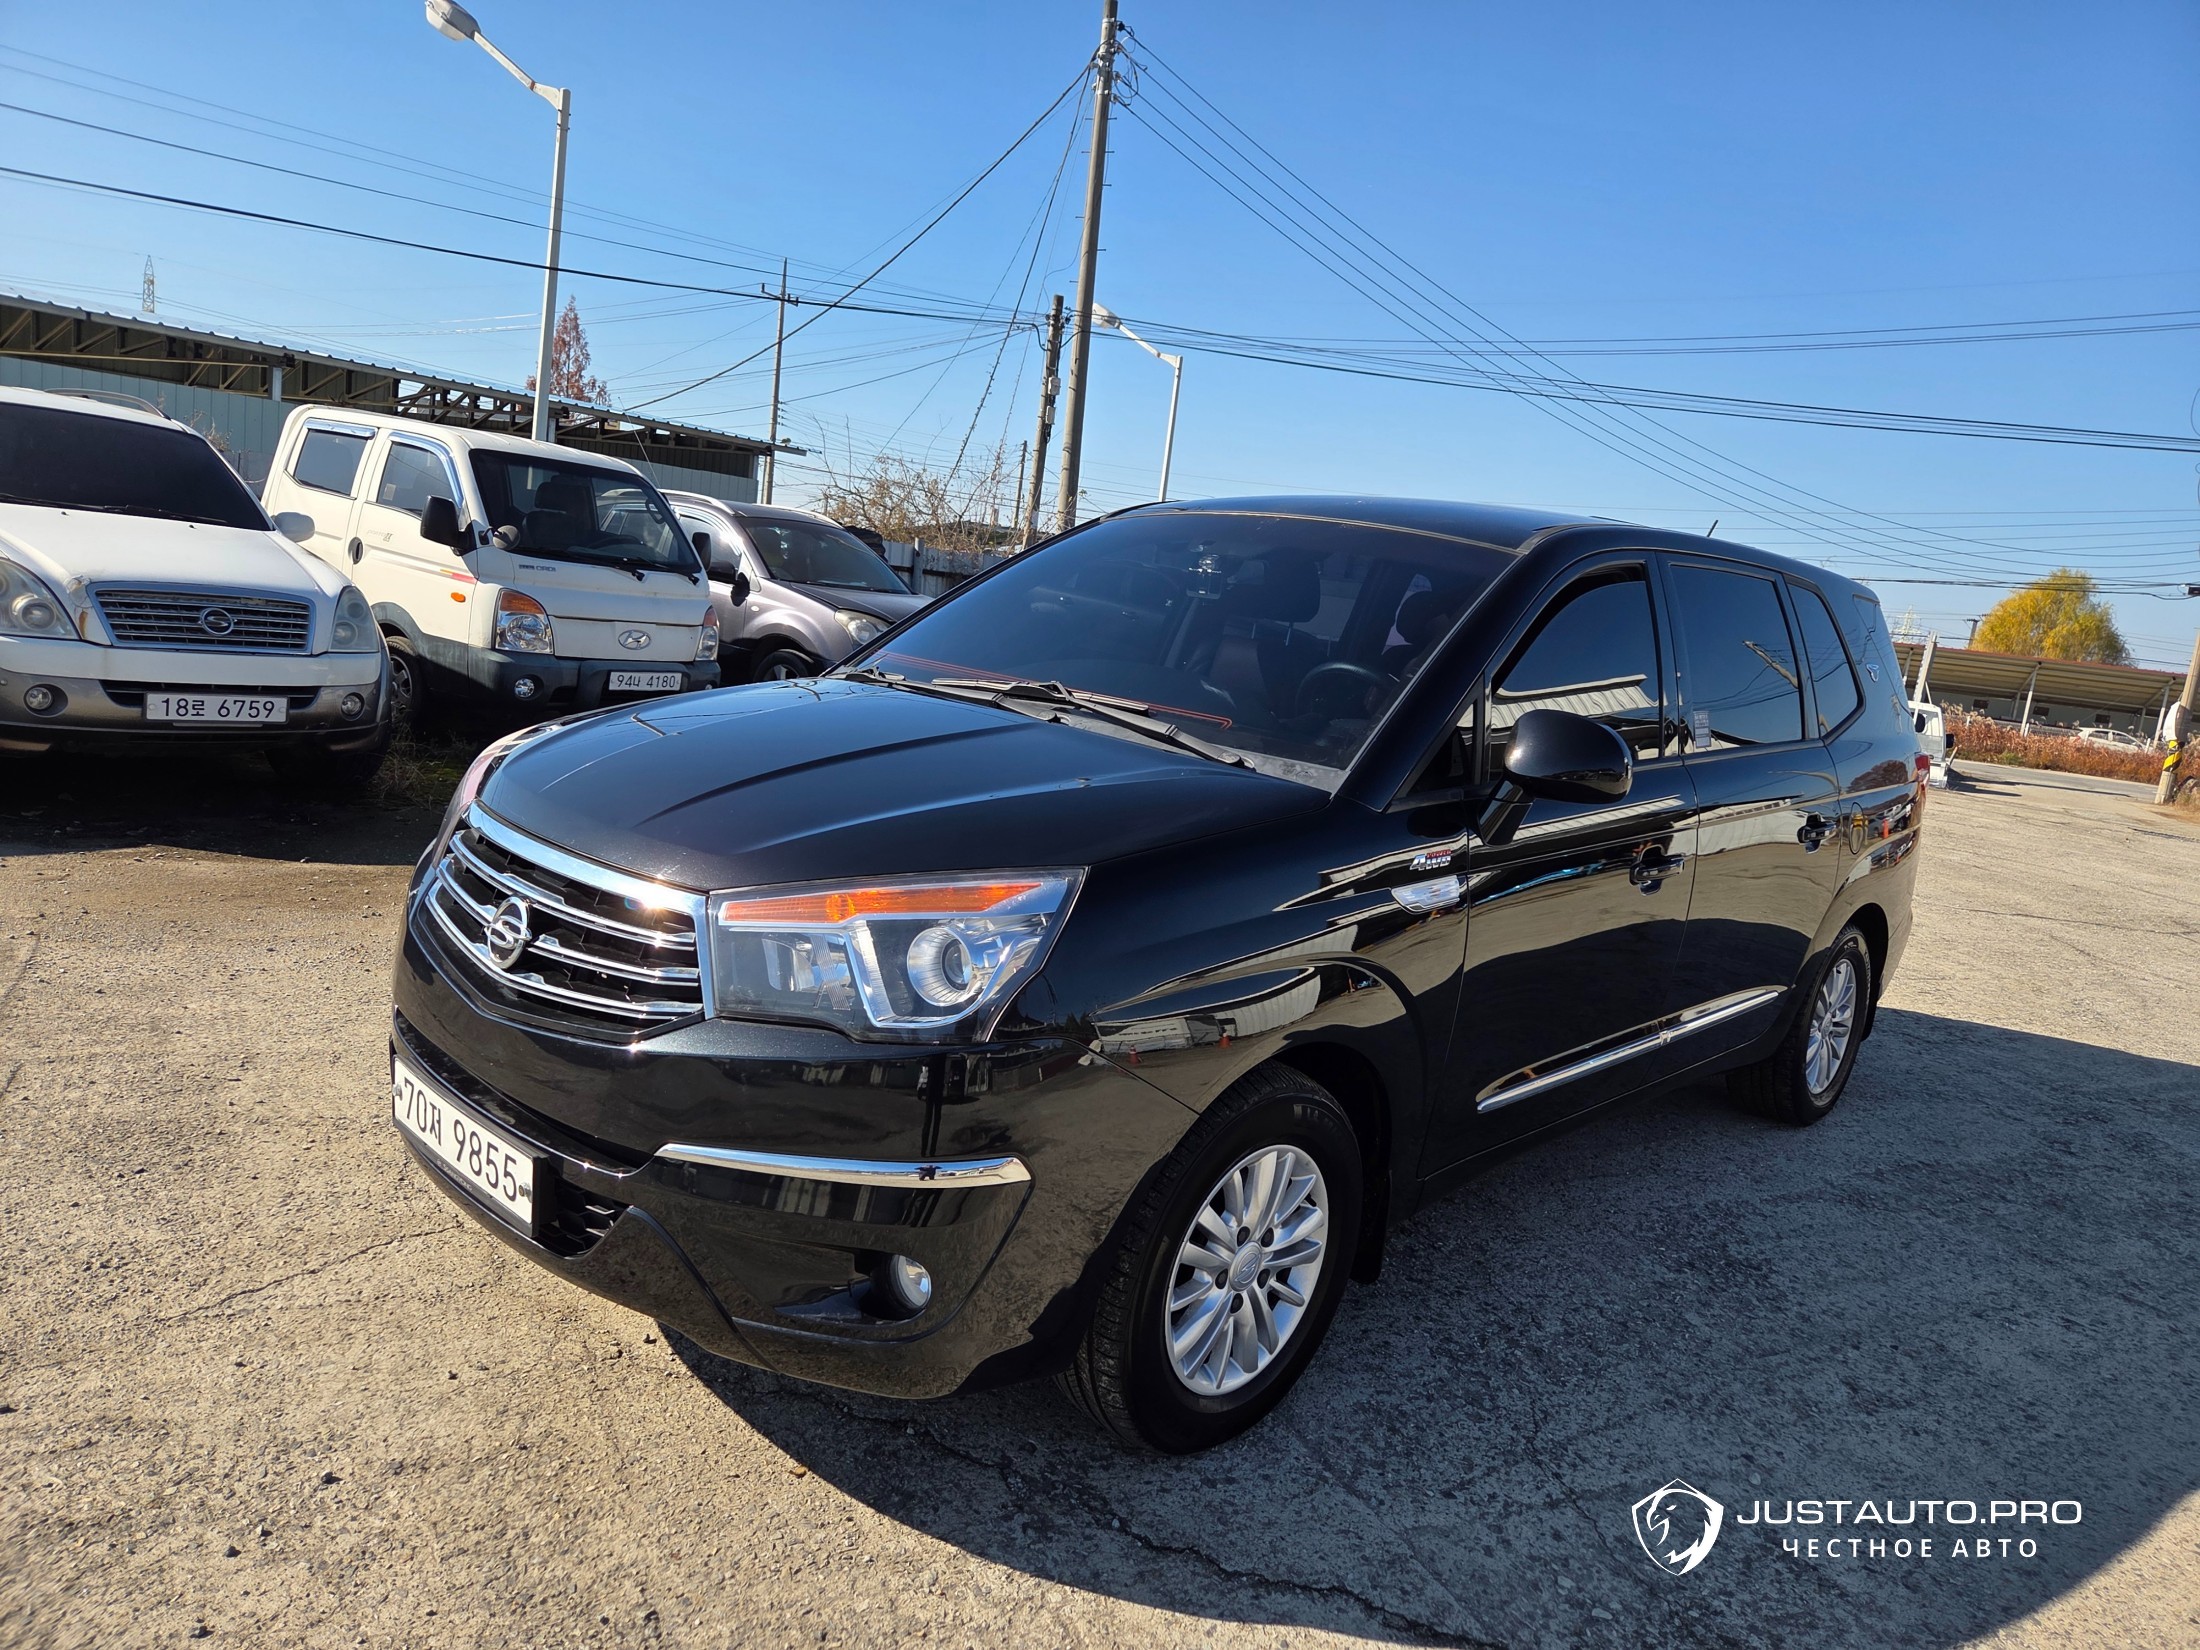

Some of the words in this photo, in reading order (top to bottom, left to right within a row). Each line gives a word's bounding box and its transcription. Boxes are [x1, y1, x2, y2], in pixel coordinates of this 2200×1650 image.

[646, 675, 676, 688] 4180
[161, 697, 205, 717] 18로
[217, 699, 275, 719] 6759
[404, 1077, 442, 1147] 70저
[453, 1119, 518, 1202] 9855
